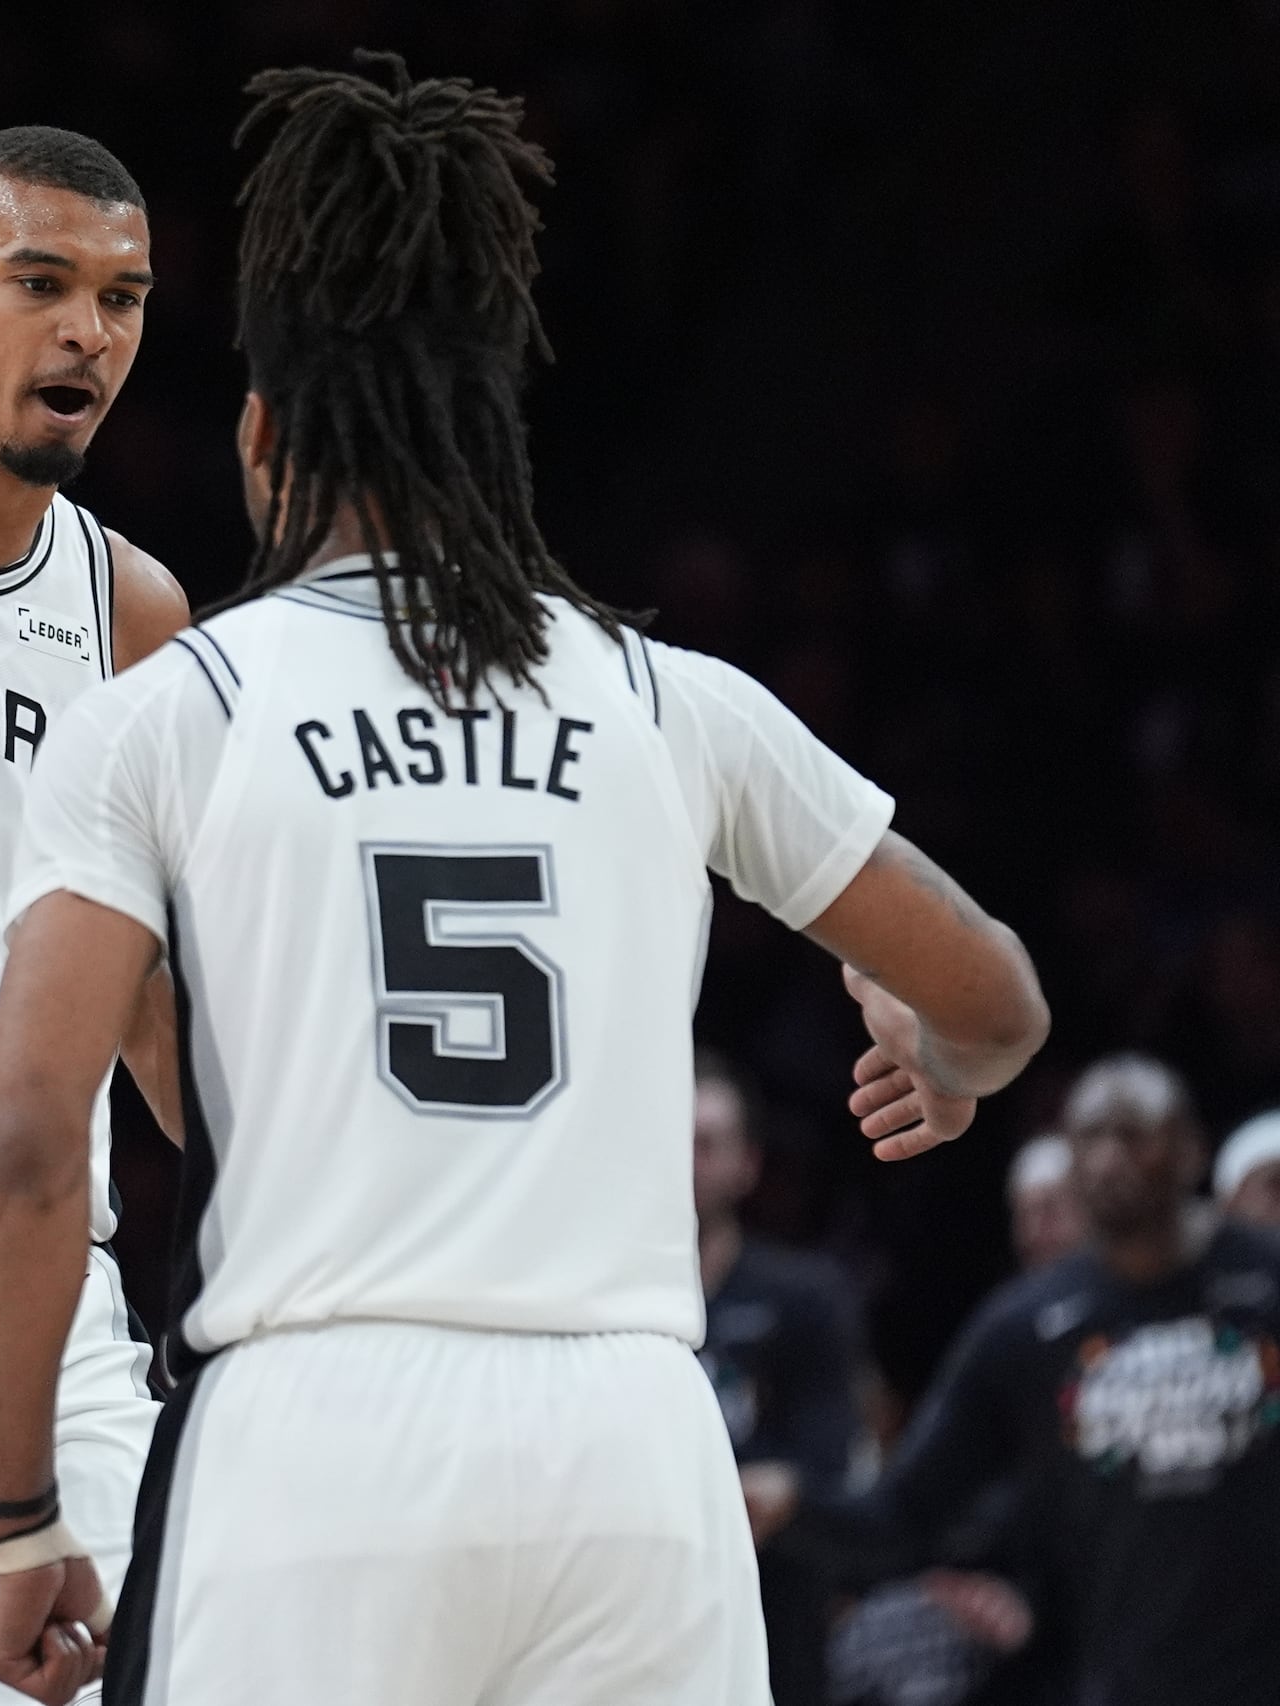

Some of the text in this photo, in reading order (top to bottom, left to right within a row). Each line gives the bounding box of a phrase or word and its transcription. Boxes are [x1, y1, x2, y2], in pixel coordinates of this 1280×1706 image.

[29, 618, 82, 649] LEDGER
[295, 708, 594, 802] CASTLE
[359, 841, 570, 1121] 5
